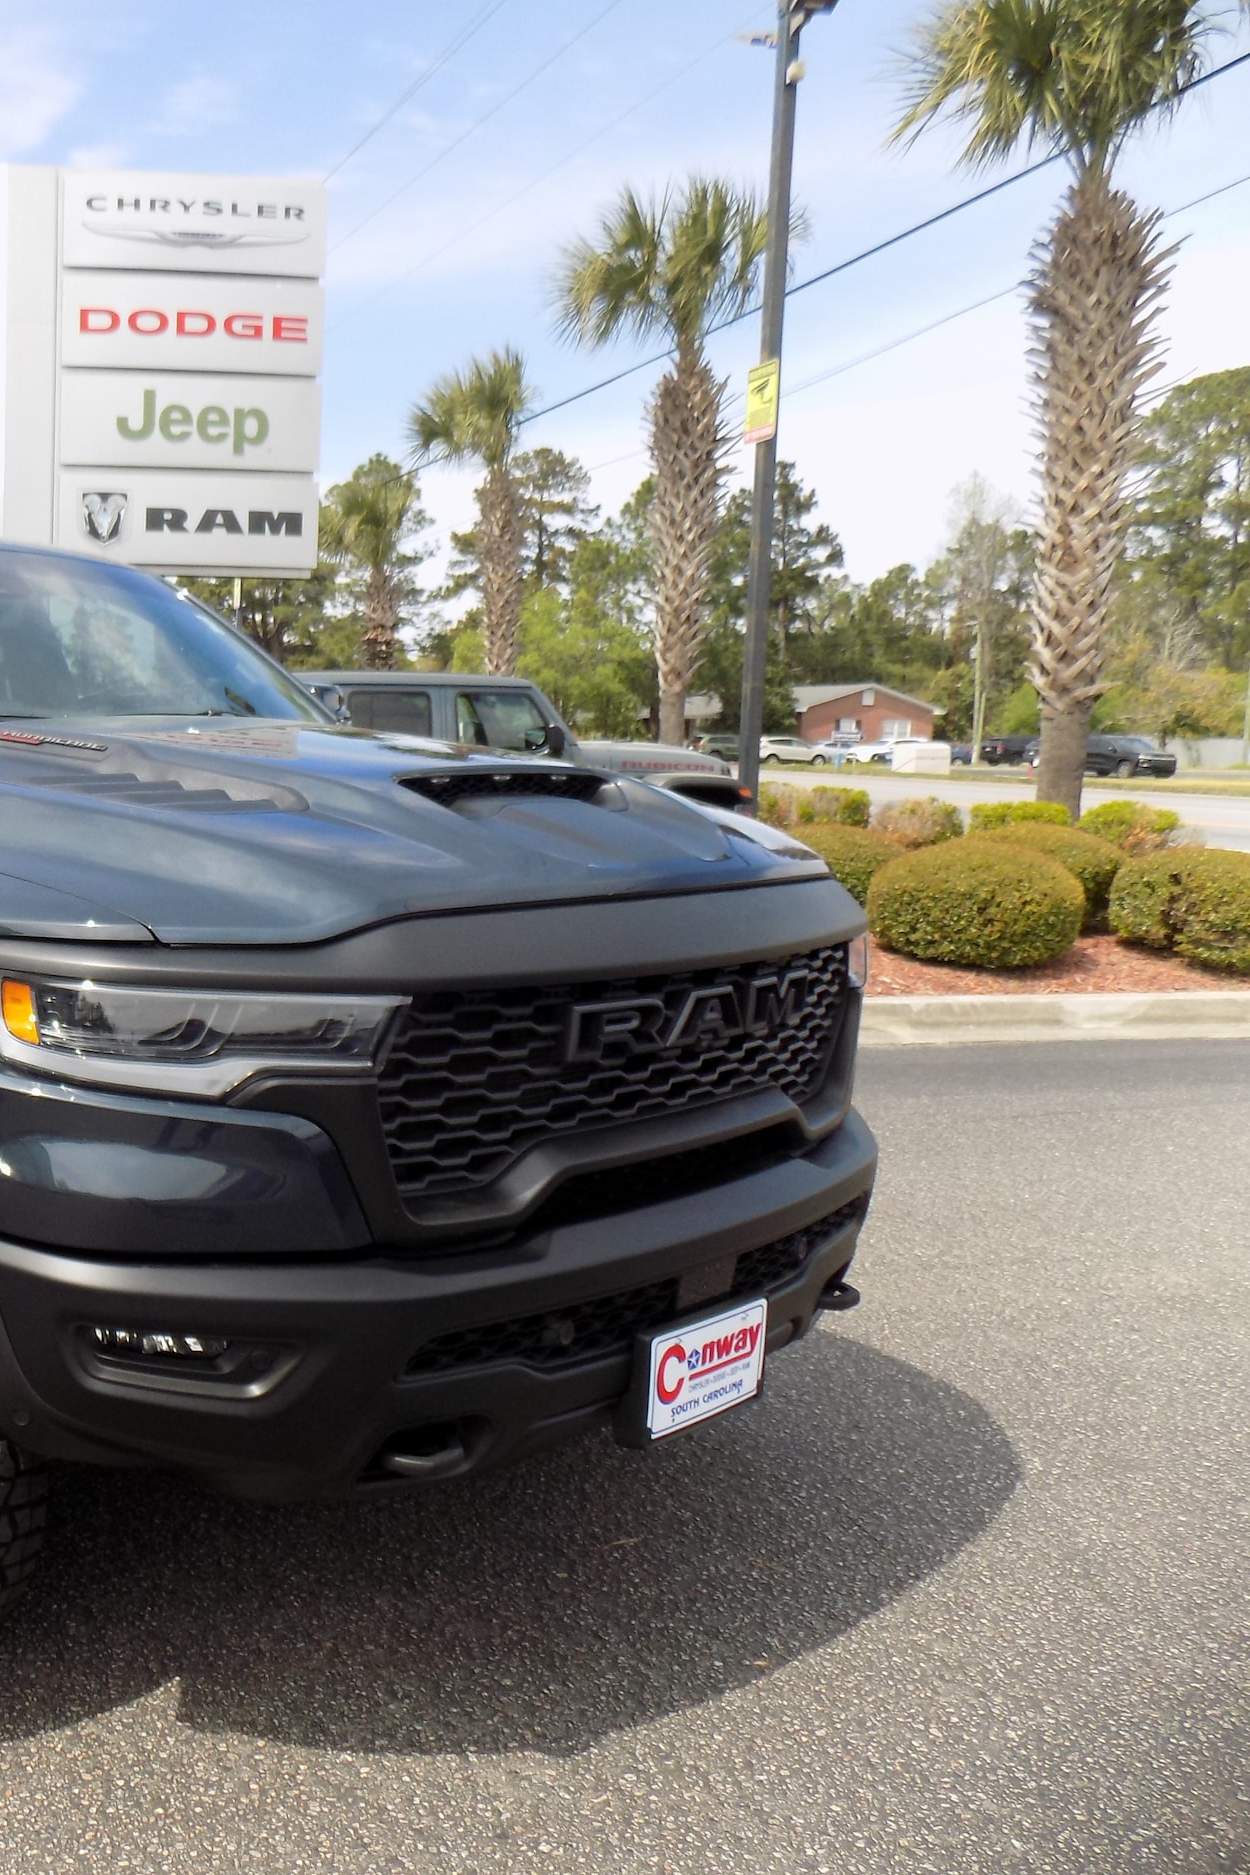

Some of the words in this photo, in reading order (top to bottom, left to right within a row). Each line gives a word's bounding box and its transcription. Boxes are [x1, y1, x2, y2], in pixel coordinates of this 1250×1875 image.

[85, 196, 306, 221] CHRYSLER
[79, 308, 309, 343] DODGE
[116, 388, 270, 456] Jeep
[145, 507, 303, 537] RAM
[621, 760, 715, 772] RUBICON
[566, 968, 810, 1062] RAM
[670, 1398, 700, 1418] SOUTH
[703, 1378, 744, 1404] CAROLINA
